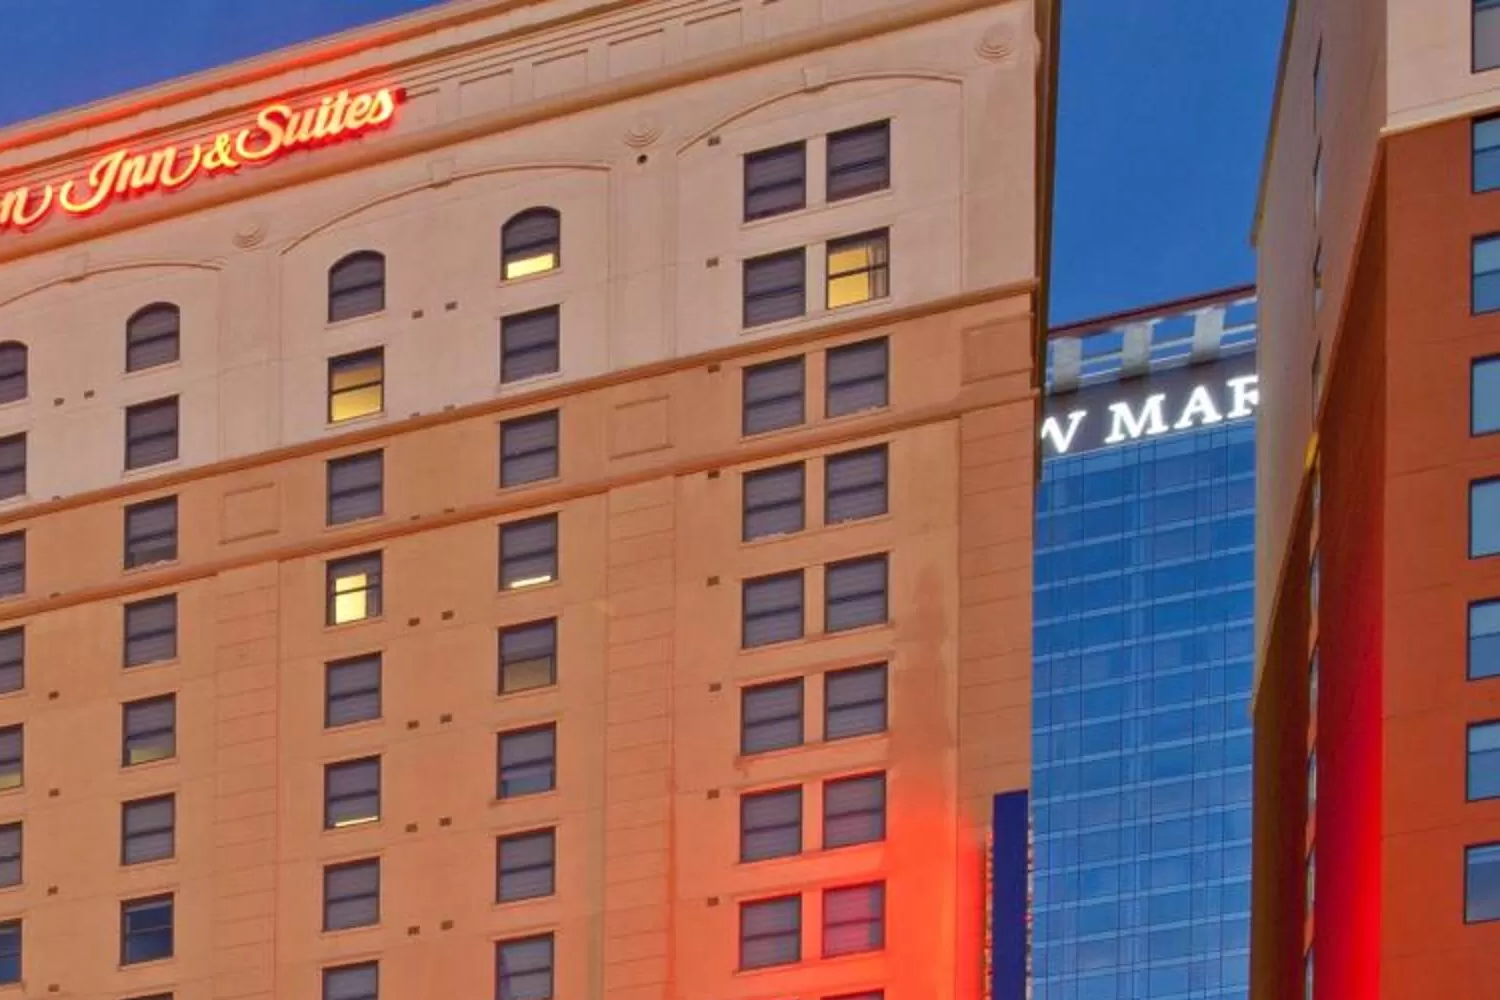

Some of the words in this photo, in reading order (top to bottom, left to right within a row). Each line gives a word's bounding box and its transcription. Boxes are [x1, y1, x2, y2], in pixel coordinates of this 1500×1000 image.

[58, 143, 201, 213] Inn
[201, 133, 240, 170] &
[235, 87, 394, 160] Suites
